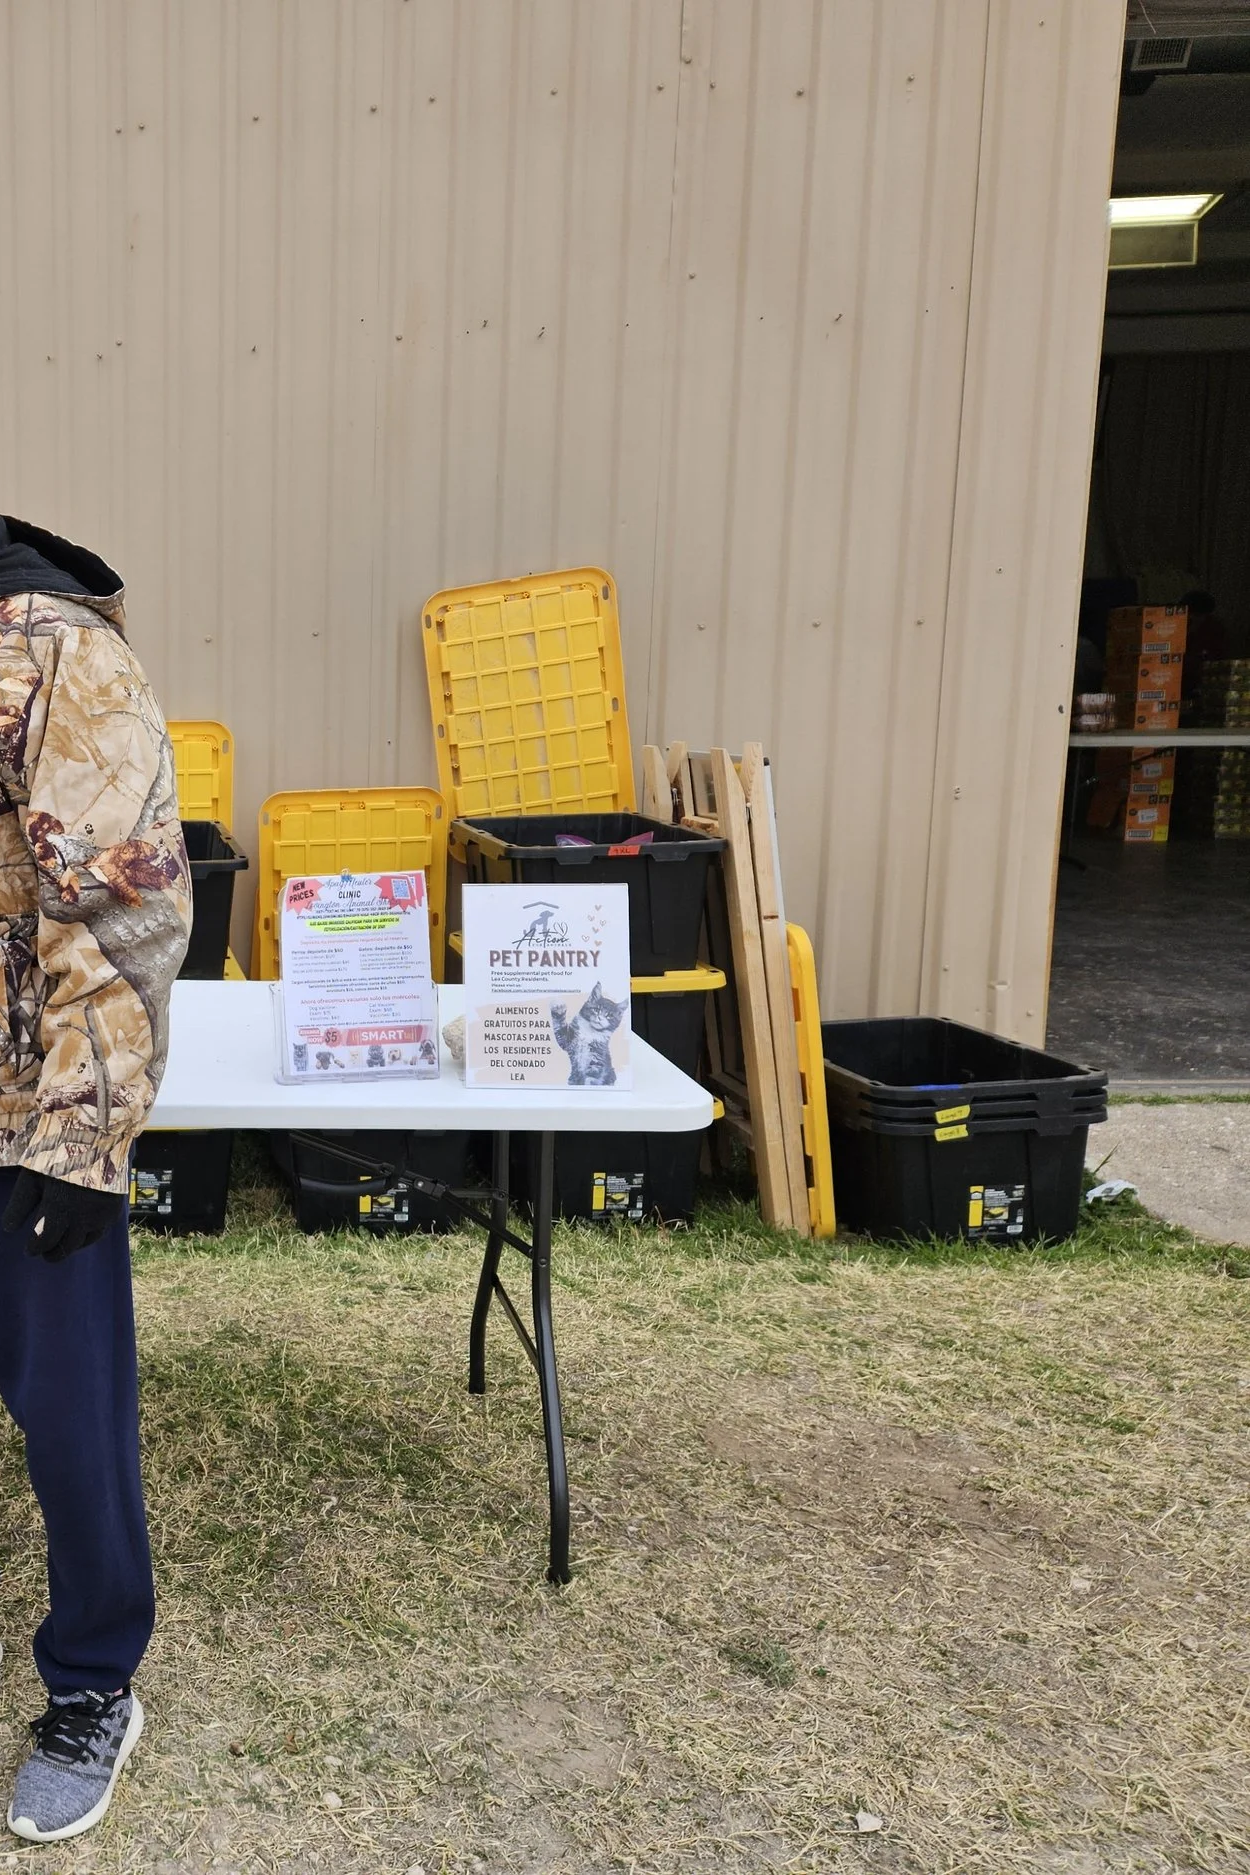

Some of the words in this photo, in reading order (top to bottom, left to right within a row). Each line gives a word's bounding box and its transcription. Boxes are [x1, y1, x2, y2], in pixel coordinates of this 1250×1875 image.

[292, 881, 306, 892] NEW
[289, 889, 315, 904] PRICES
[338, 890, 361, 899] CLINIC
[512, 927, 569, 949] Action
[490, 950, 523, 967] PET
[528, 950, 600, 967] PANTRY
[495, 1007, 539, 1015] ALIMENTOS
[484, 1020, 527, 1028] GRATUITOS
[529, 1020, 550, 1028] PARA
[325, 1031, 337, 1043] $5
[361, 1030, 404, 1041] SMART
[484, 1033, 527, 1041] MASCOTAS
[529, 1033, 551, 1041] PARA
[507, 1060, 546, 1068] CONDADO
[510, 1073, 525, 1081] LEA
[86, 1690, 105, 1703] adidas
